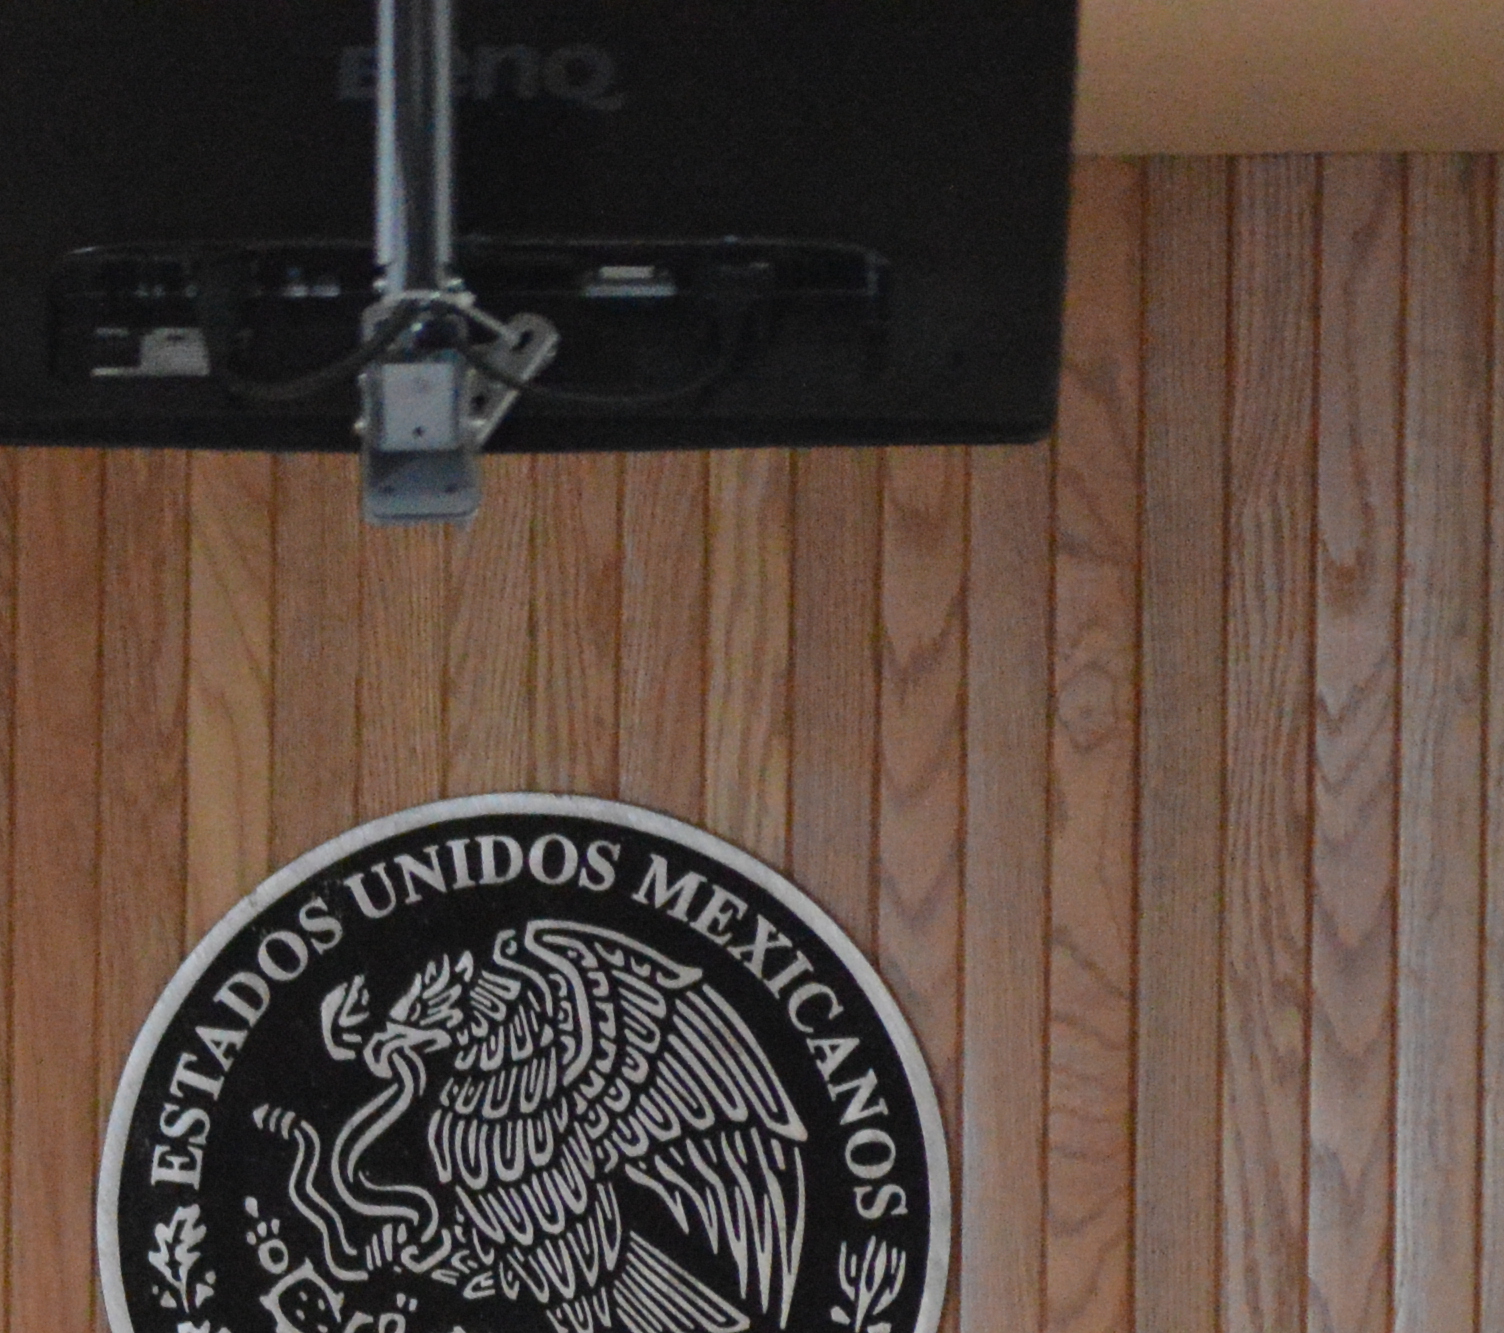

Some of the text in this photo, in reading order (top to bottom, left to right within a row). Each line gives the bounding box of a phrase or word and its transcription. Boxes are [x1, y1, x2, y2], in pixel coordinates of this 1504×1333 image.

[151, 832, 910, 1222] ESTADOS UNIDOS MEXICANOS
